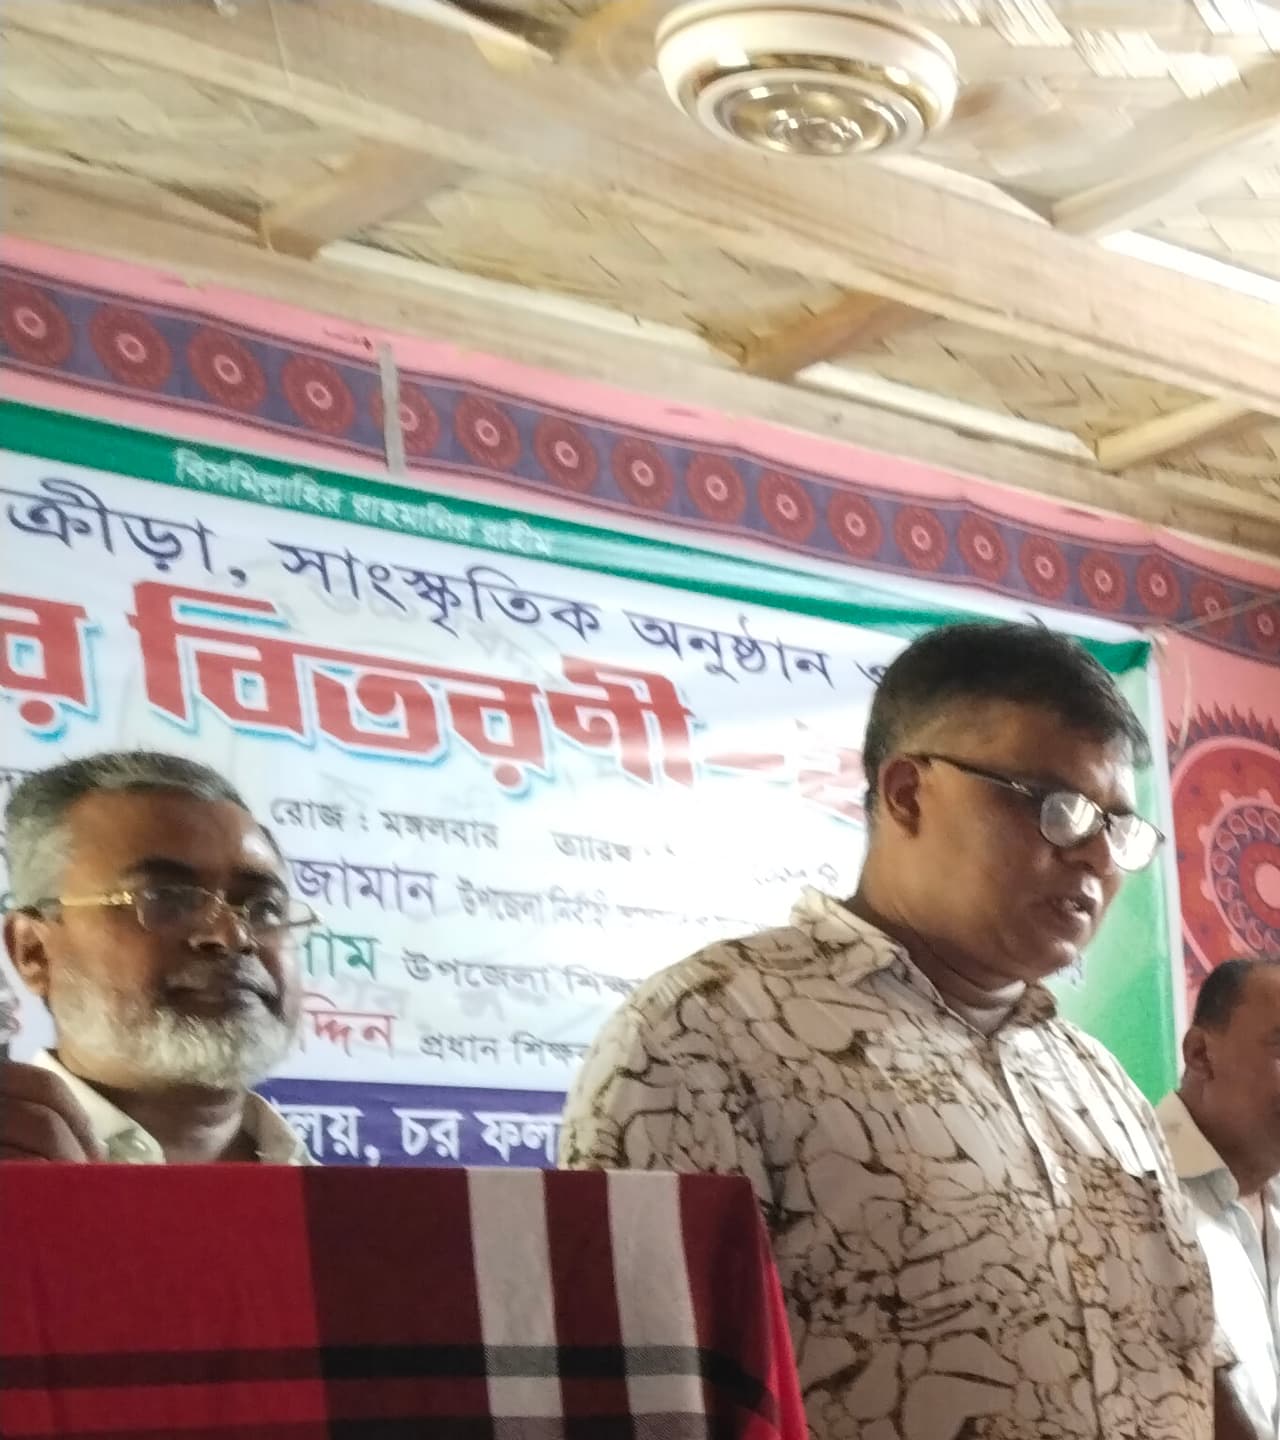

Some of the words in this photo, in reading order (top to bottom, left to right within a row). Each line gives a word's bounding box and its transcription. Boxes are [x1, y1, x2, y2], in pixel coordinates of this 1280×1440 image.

[0, 478, 247, 587] ক্রীড়া,
[267, 537, 603, 643] সাংস্কৃতিক
[622, 612, 835, 688] অনুষ্ঠান
[128, 580, 697, 790] বিতরণী
[271, 799, 346, 831] রোজ
[379, 808, 500, 851] মঙ্গলবার
[401, 947, 550, 992] উপজেলা
[563, 964, 645, 998] শিক্ষ
[419, 1032, 500, 1064] প্রধান
[271, 1096, 380, 1167] লয়,
[393, 1107, 464, 1160] চর
[473, 1111, 566, 1163] ফল
